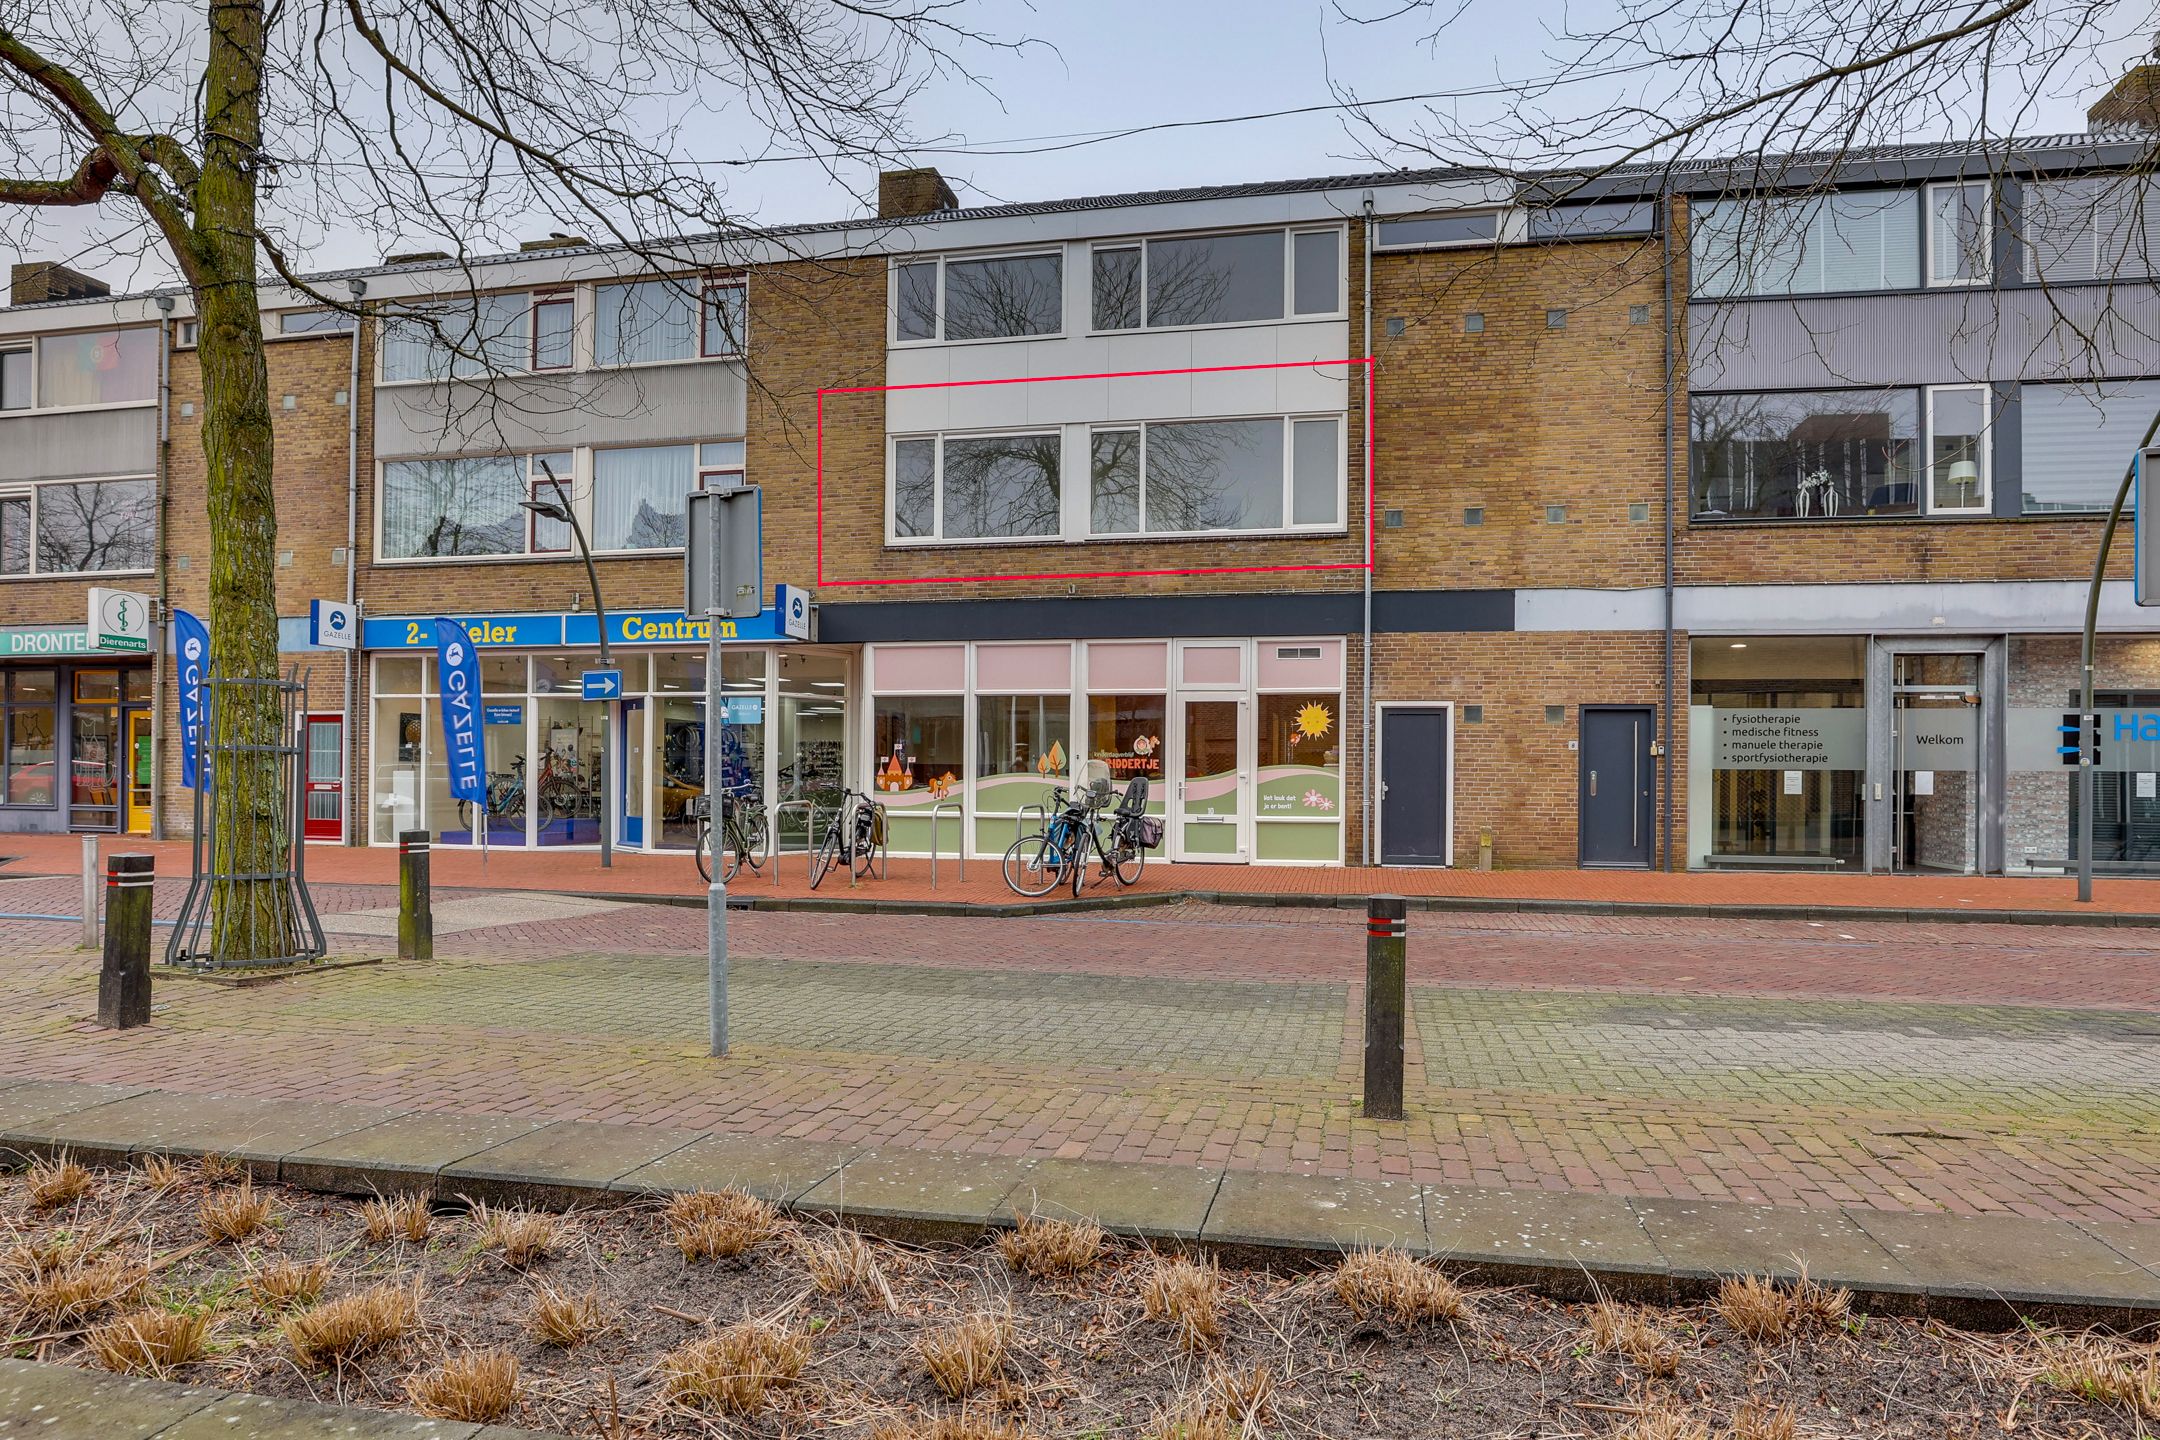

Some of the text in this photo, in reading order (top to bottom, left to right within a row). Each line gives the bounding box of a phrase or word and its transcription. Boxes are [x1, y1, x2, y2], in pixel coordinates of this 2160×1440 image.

[622, 617, 738, 640] Centrum
[789, 618, 806, 630] GAZELLE
[323, 630, 352, 641] GAZELLE
[11, 632, 91, 652] DRONTE
[100, 636, 147, 649] Dierenarts
[1732, 714, 1801, 725] fysiotherapie
[1732, 727, 1819, 737] medische fitness
[1916, 734, 1964, 744] Welkom
[1732, 740, 1823, 751] manuele therapie
[1732, 753, 1828, 764] sportfysiotherapie
